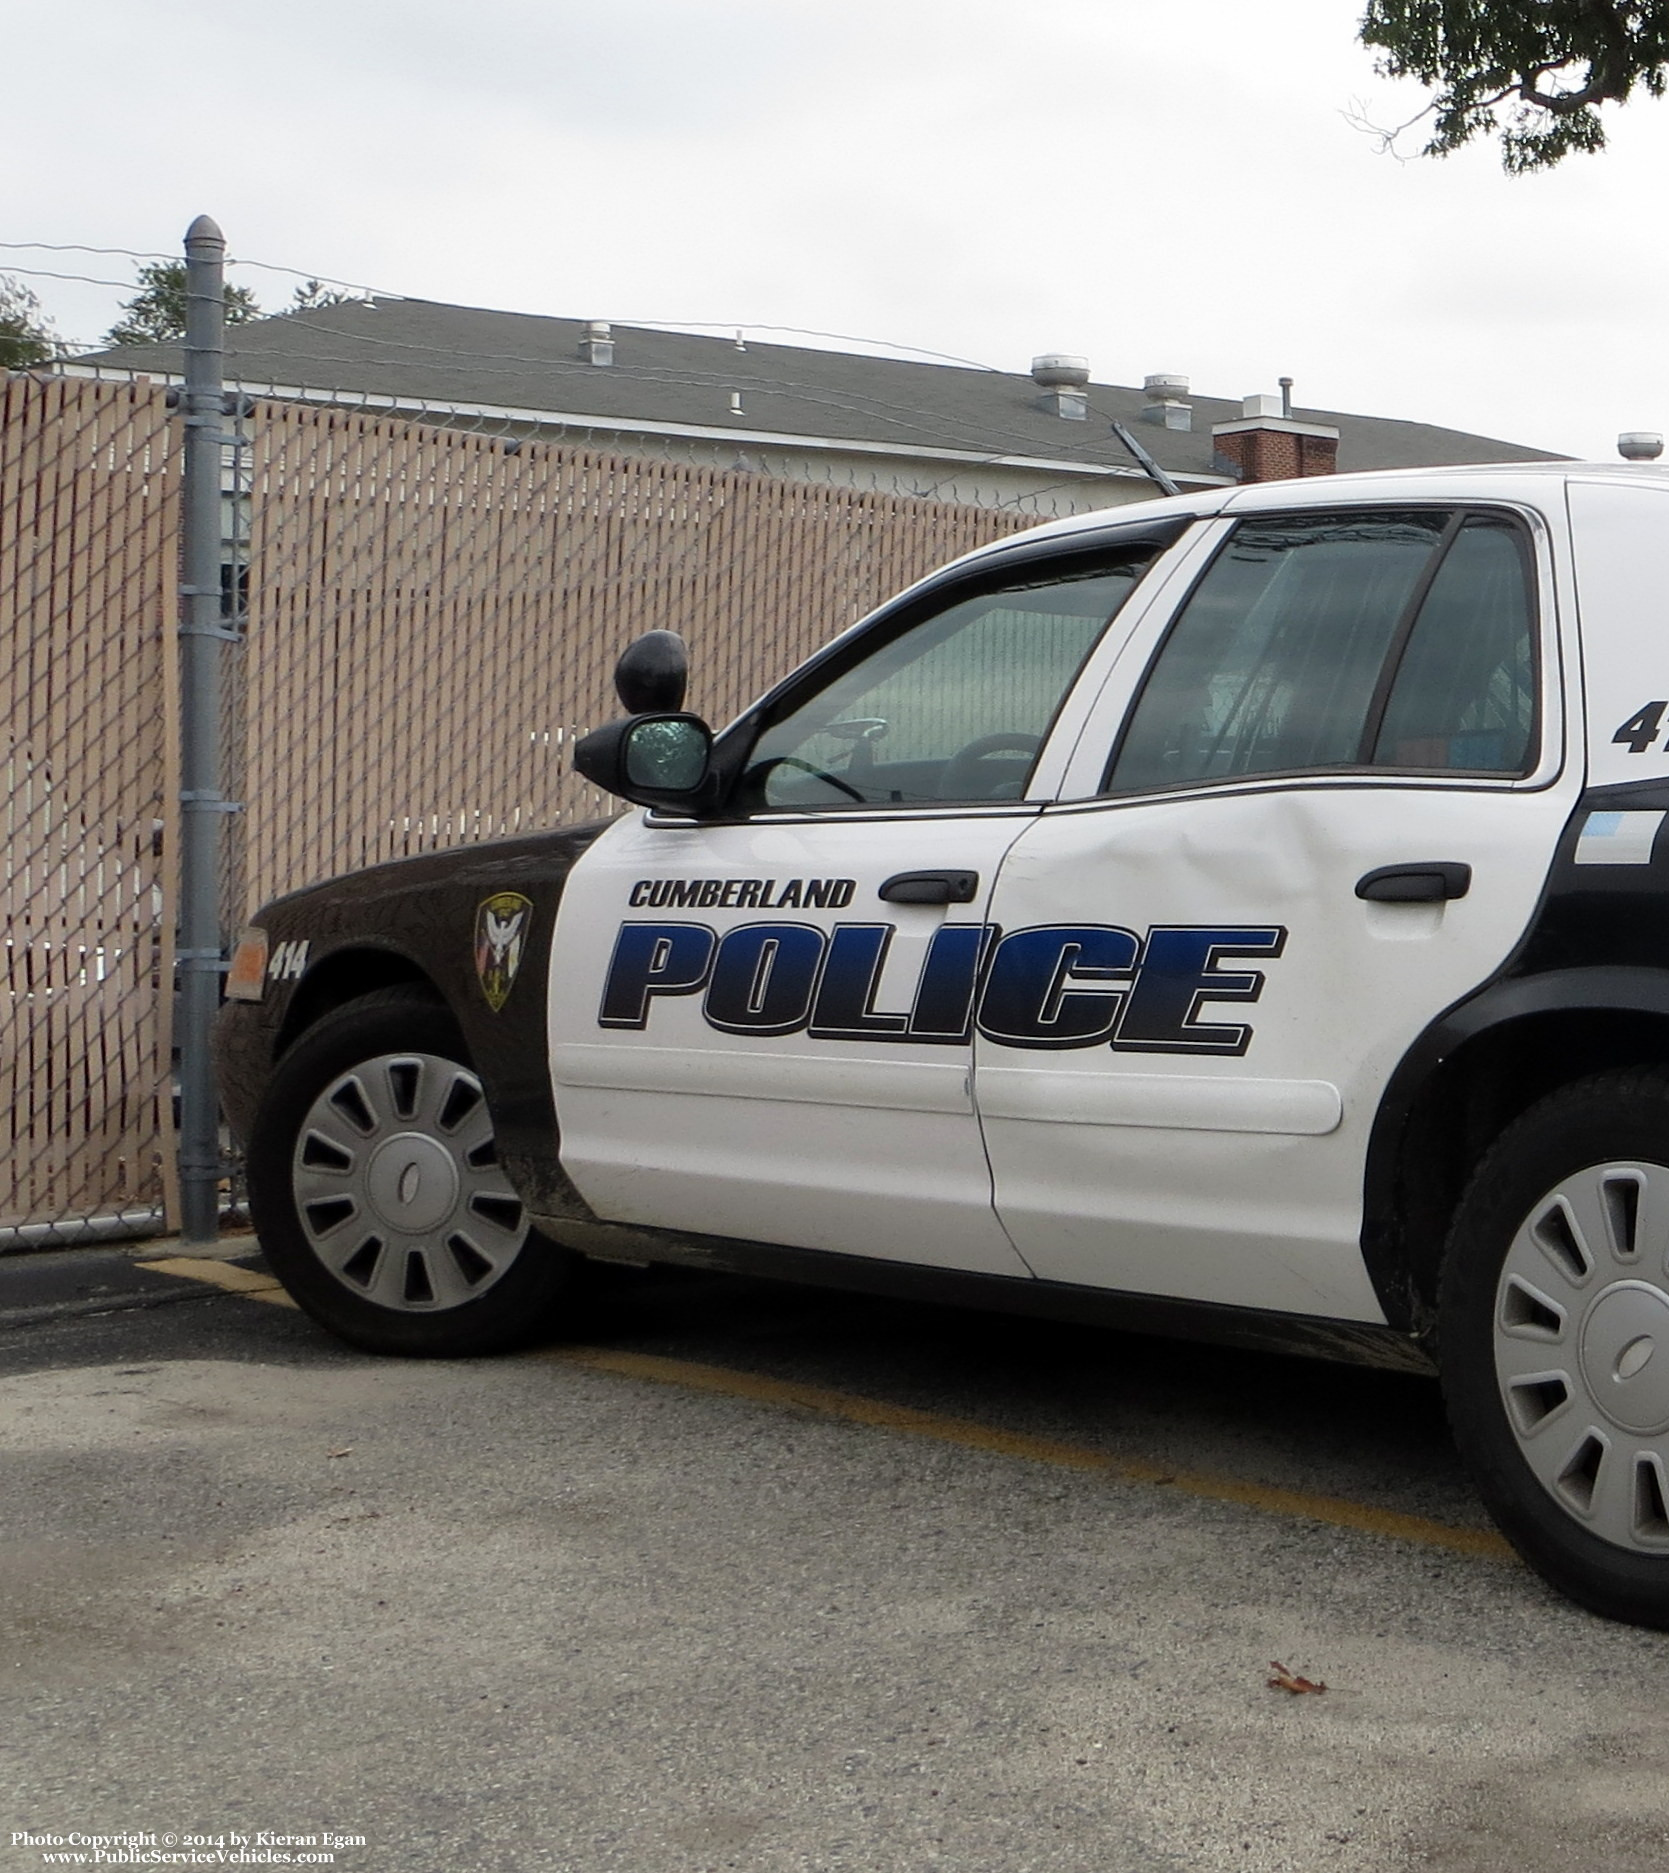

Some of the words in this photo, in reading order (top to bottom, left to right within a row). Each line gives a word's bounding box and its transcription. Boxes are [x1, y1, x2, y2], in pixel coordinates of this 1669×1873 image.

[628, 879, 857, 909] CUMBERLAND
[268, 940, 310, 980] 414
[598, 920, 1289, 1057] POLICE
